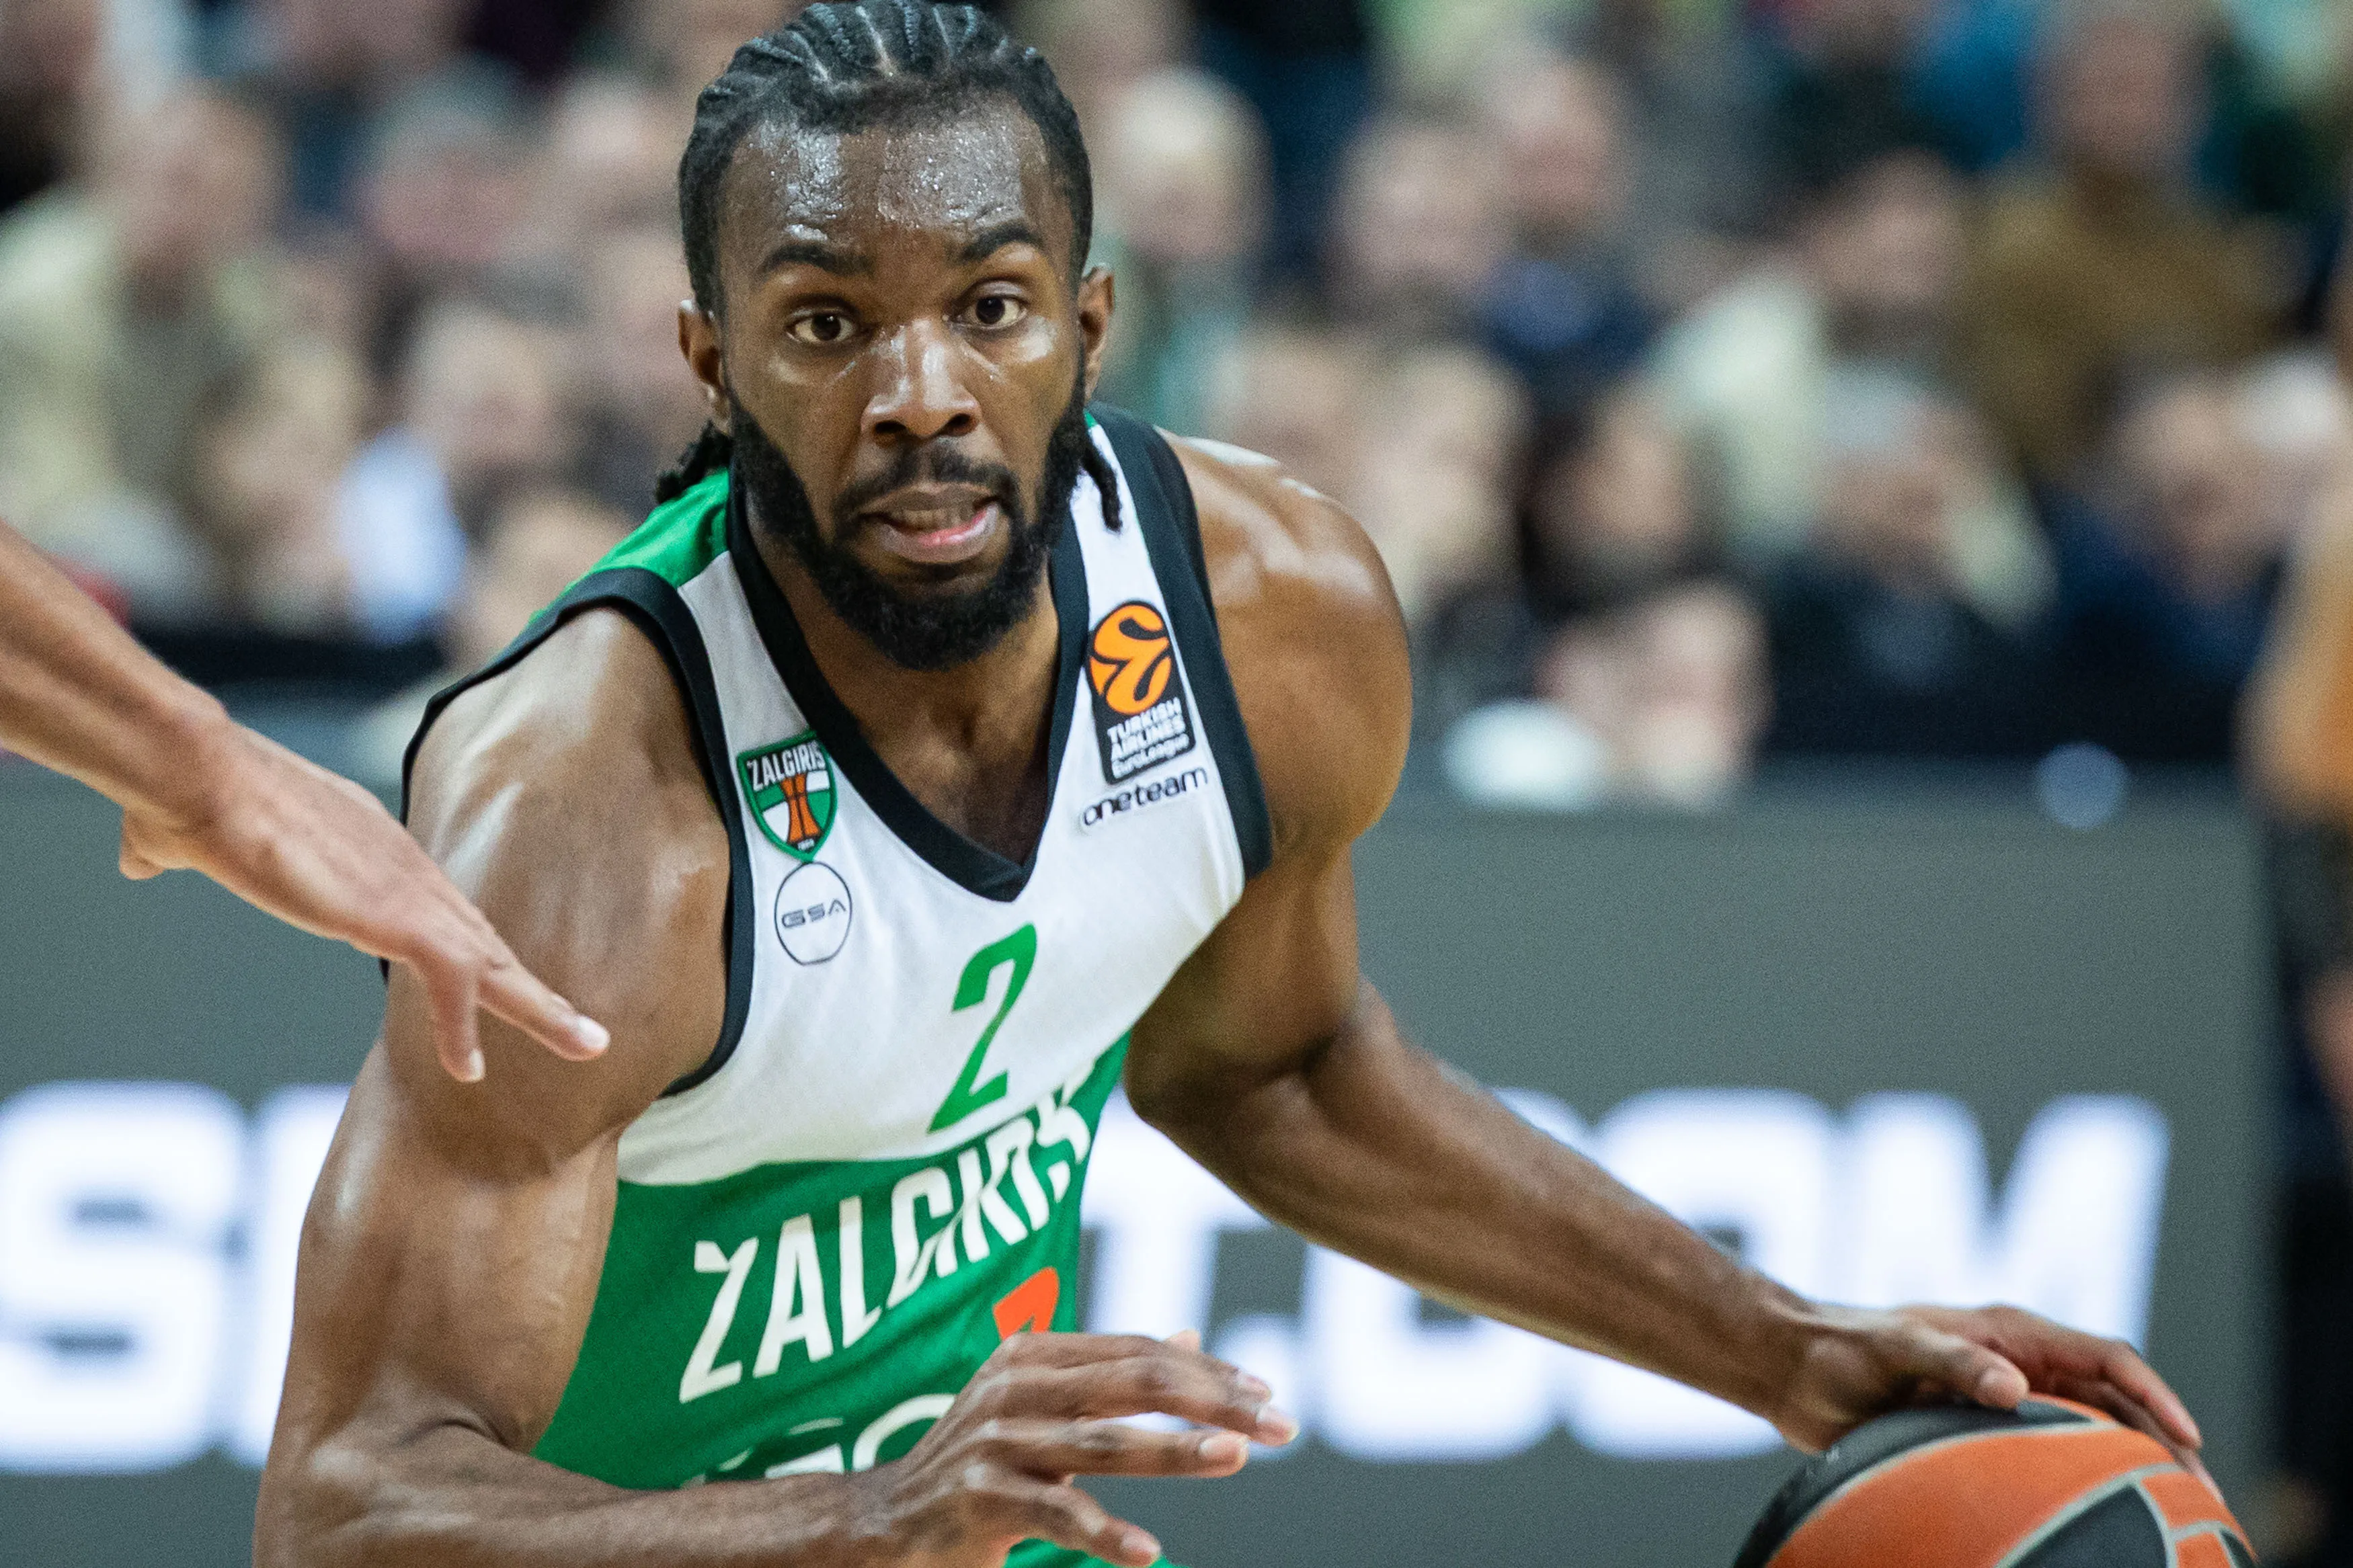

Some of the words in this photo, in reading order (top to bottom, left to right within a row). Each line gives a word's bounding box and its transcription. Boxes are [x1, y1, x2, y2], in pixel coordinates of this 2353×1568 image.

[1083, 768, 1208, 825] oneteam
[781, 899, 847, 929] GSA
[926, 922, 1037, 1134] 2
